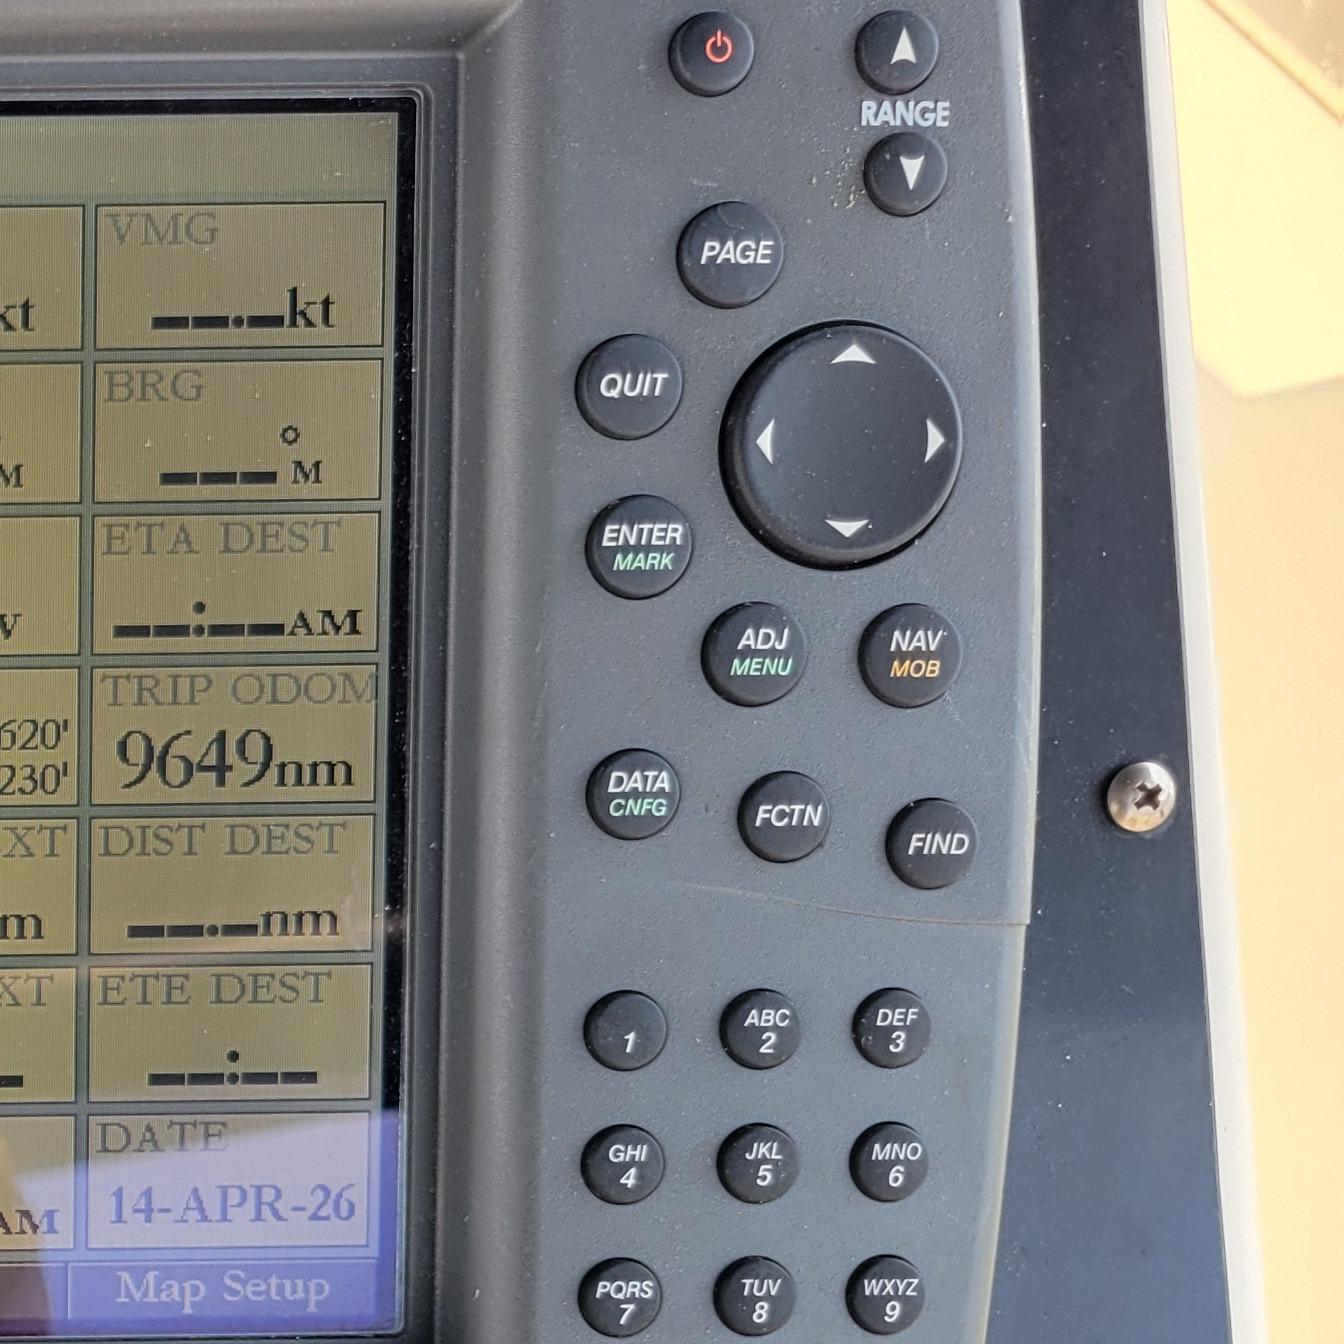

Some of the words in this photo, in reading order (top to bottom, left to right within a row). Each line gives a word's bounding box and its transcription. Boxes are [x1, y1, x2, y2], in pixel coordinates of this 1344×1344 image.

[860, 99, 951, 128] RANGE
[105, 211, 219, 246] VMG
[700, 239, 774, 265] PAGE
[104, 369, 204, 403] BRG
[599, 372, 669, 398] QUIT
[101, 521, 200, 556] ETA
[218, 518, 343, 554] DEST
[601, 524, 683, 548] ENTER
[612, 552, 674, 571] MARK
[737, 627, 790, 652] ADJ
[890, 629, 944, 652] NAV
[730, 657, 793, 677] MENU
[890, 659, 941, 679] MOB
[99, 672, 214, 707] TRIP
[230, 671, 378, 705] ODOM
[607, 769, 671, 794] DATA
[609, 797, 667, 818] CNFG
[754, 803, 823, 827] FCTN
[98, 823, 206, 858] DIST
[224, 820, 348, 856] DEST
[907, 831, 970, 856] FIND
[96, 972, 192, 1006] ETE
[211, 970, 333, 1004] DEST
[744, 1008, 791, 1027] ABC
[875, 1007, 919, 1027] DEF
[623, 1030, 637, 1054] 1
[758, 1032, 776, 1054] 2
[888, 1031, 905, 1054] 3
[95, 1121, 229, 1154] DATE
[608, 1144, 648, 1163] GHI
[745, 1142, 783, 1161] JKL
[871, 1142, 923, 1162] MNO
[619, 1167, 637, 1189] 4
[755, 1165, 773, 1187] 5
[888, 1165, 905, 1188] 6
[109, 1182, 358, 1225] 14-APR-26
[114, 1270, 207, 1313] Map
[222, 1269, 330, 1312] Setup
[595, 1280, 654, 1299] PQRS
[741, 1278, 781, 1297] TUV
[863, 1278, 920, 1297] WXYZ
[618, 1303, 636, 1326] 7
[752, 1301, 769, 1324] 8
[883, 1300, 901, 1324] 9
